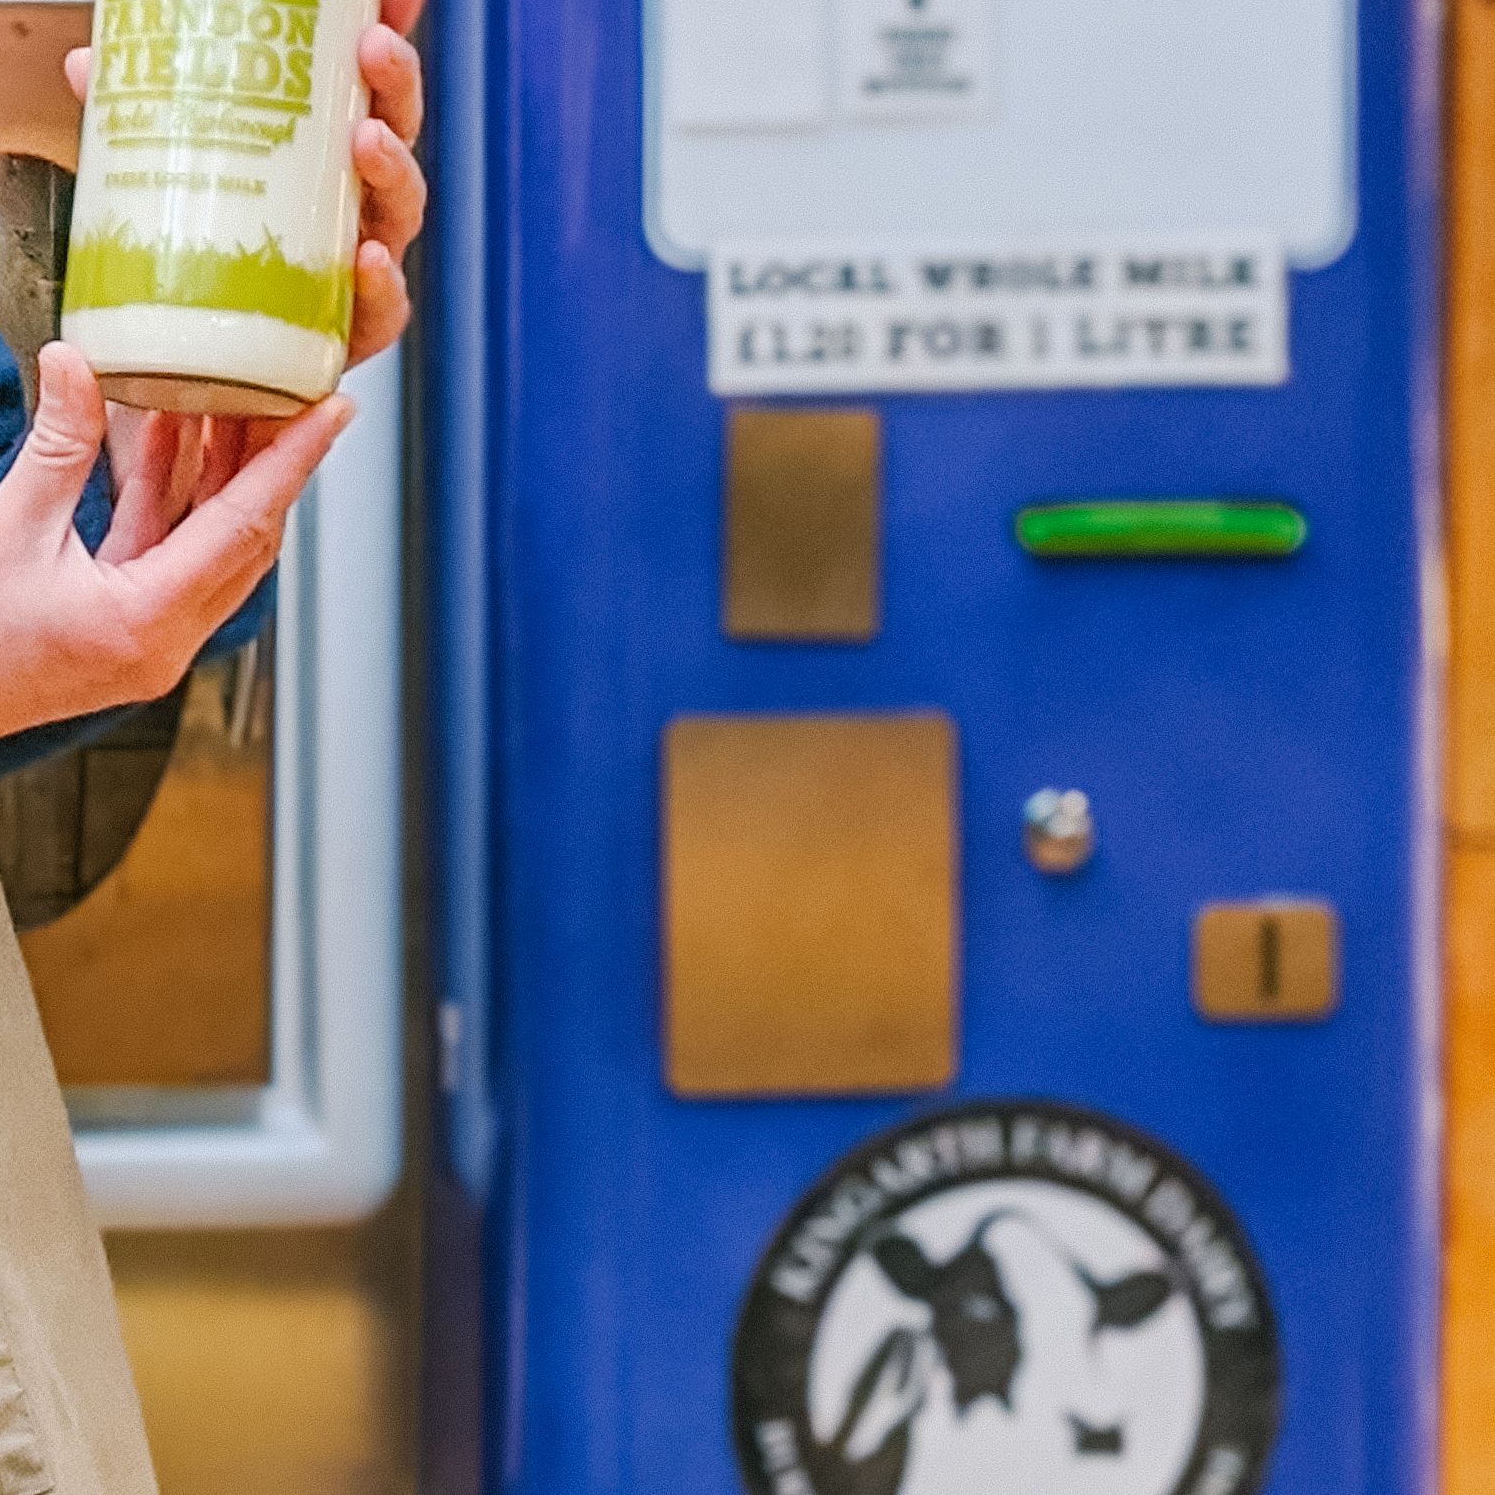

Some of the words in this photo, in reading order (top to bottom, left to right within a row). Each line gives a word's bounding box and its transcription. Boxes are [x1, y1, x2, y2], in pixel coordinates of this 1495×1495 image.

[96, 39, 312, 98] FIELDS
[729, 259, 894, 297] LOCAL
[918, 256, 1098, 294] WHOLE
[1124, 254, 1260, 290] MILK
[886, 317, 1002, 359] FOR
[1076, 314, 1258, 357] LITRE
[1011, 1118, 1160, 1199] FARM
